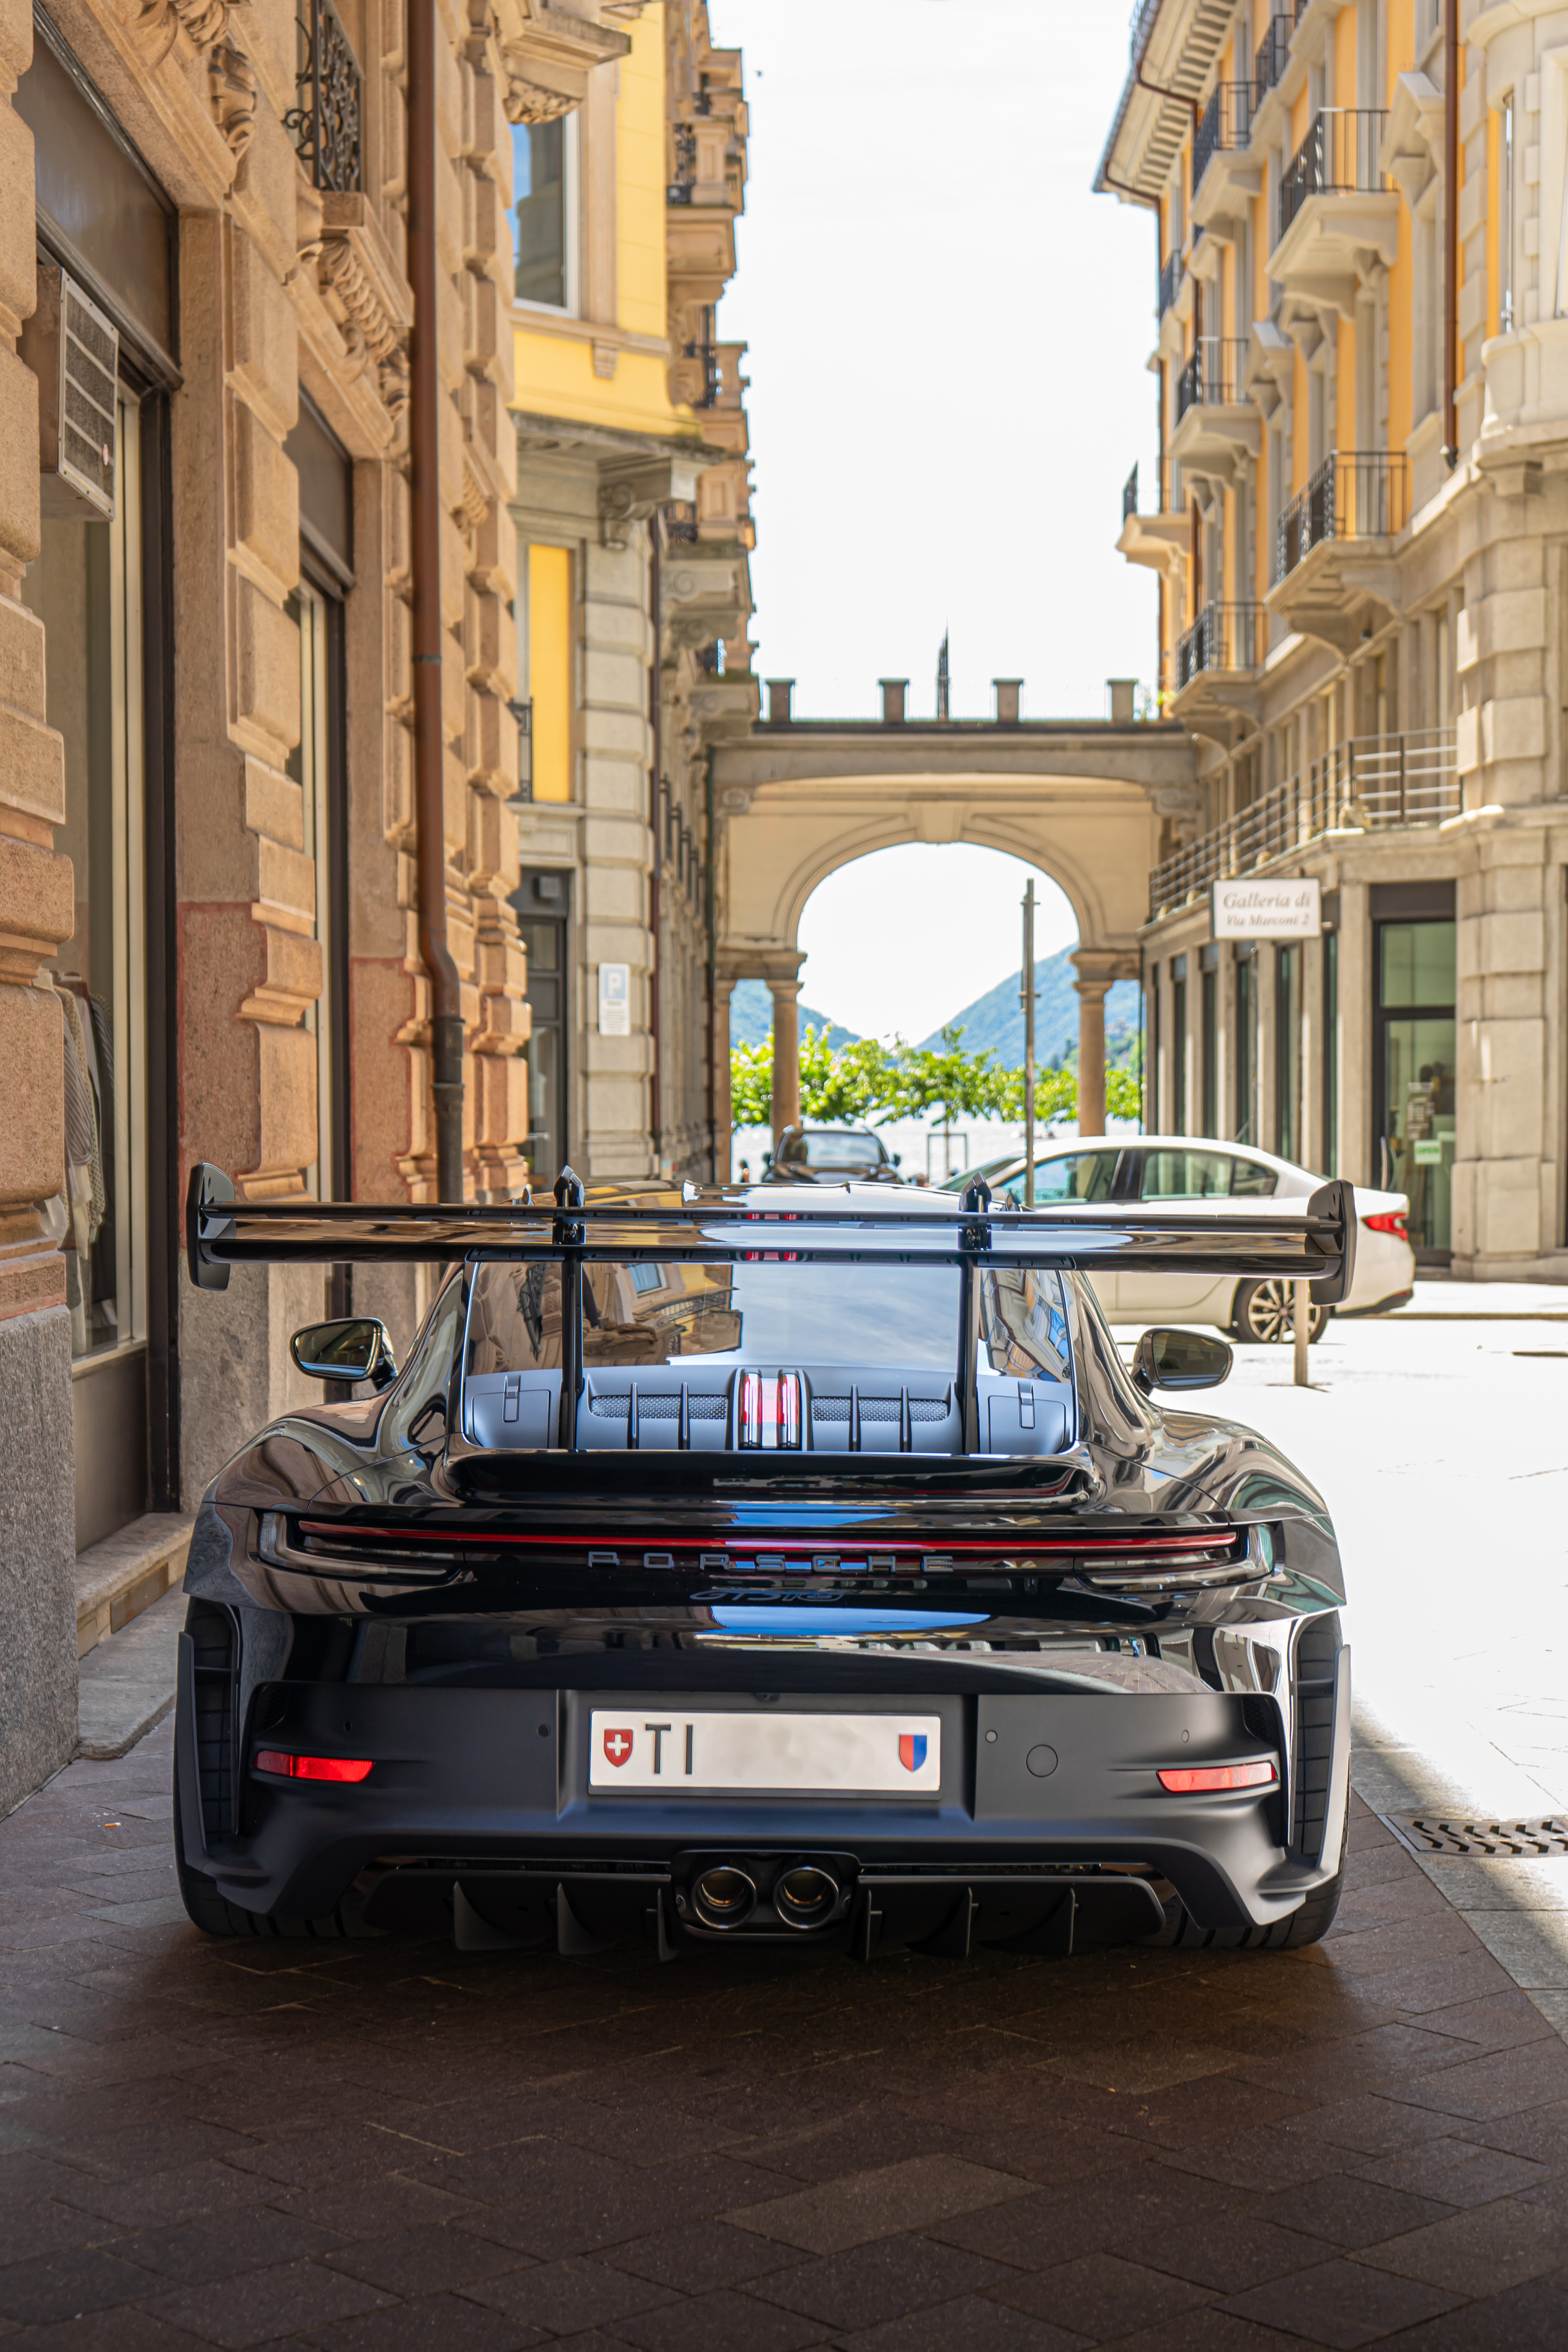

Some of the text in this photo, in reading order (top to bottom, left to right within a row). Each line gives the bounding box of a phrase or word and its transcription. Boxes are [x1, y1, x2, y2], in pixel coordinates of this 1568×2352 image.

[1223, 890, 1311, 909] Galleria di
[1227, 912, 1310, 926] Via Marconi 2
[608, 972, 622, 997] P
[1416, 1146, 1439, 1154] OPEN
[588, 1551, 953, 1573] PORSCHE
[645, 1724, 694, 1775] TI
